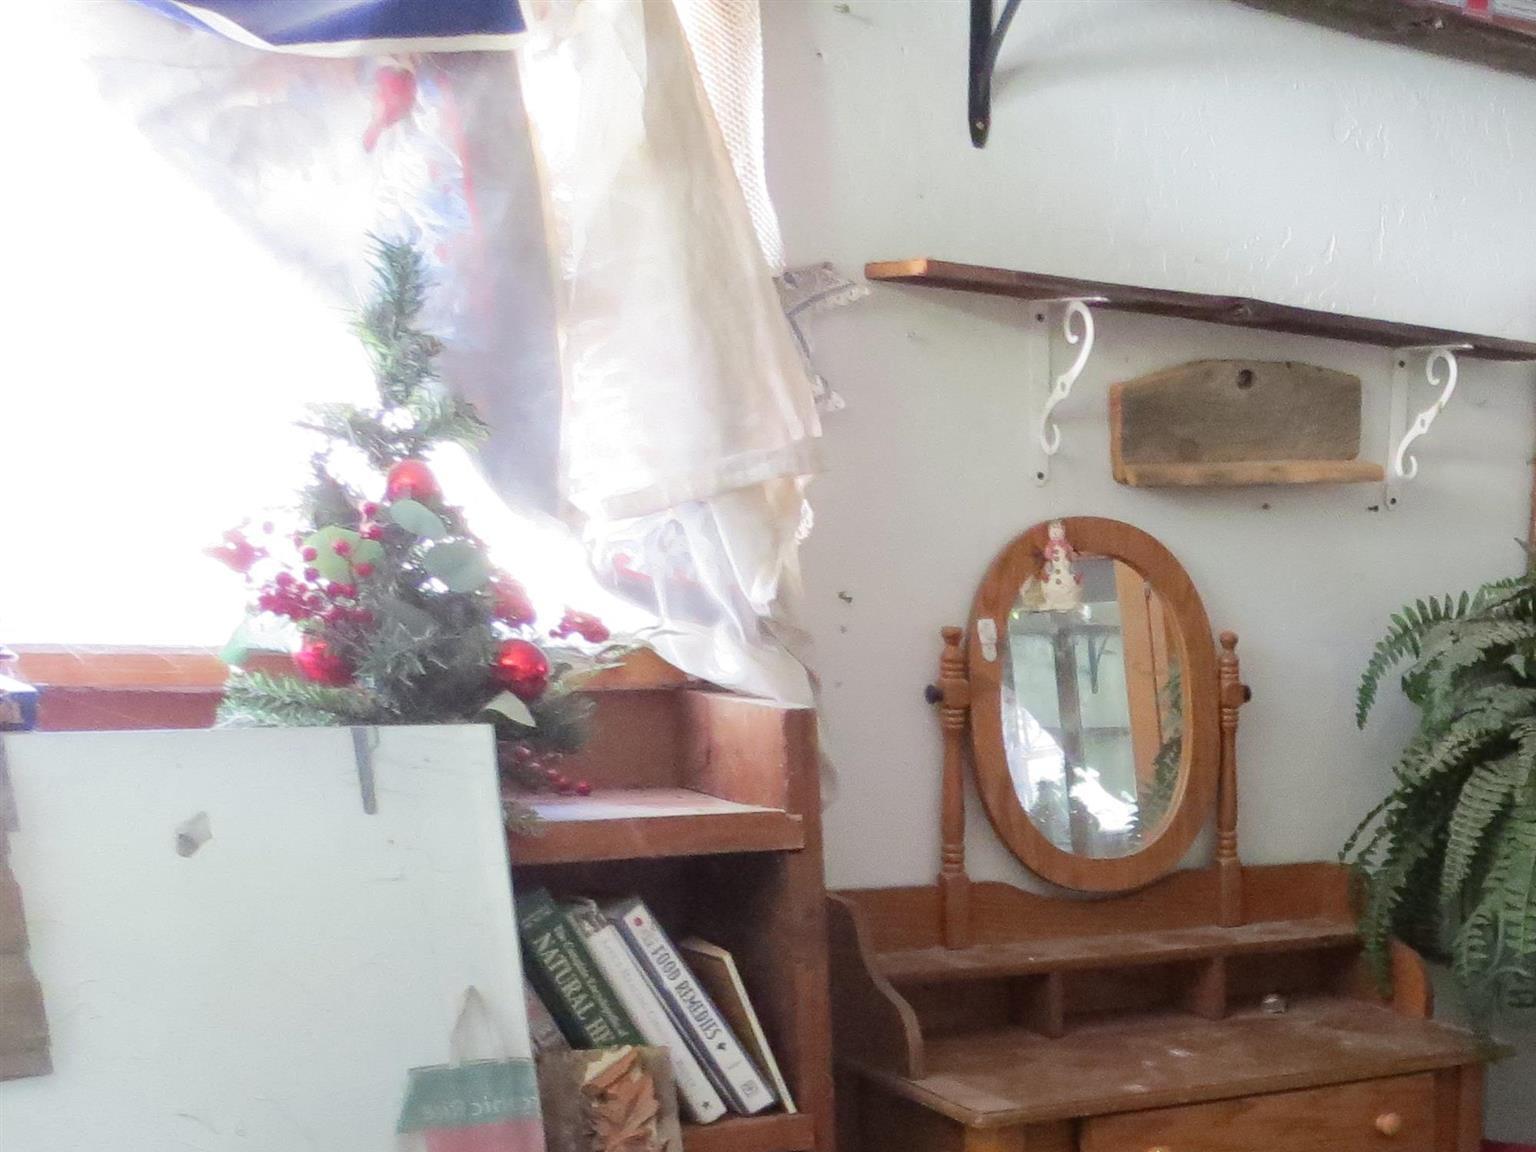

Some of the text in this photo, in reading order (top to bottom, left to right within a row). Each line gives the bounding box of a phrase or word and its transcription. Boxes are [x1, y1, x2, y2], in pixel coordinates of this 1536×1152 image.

[533, 931, 595, 1021] NATURAL
[650, 943, 682, 981] FOOD
[674, 980, 723, 1041] REMEDIES
